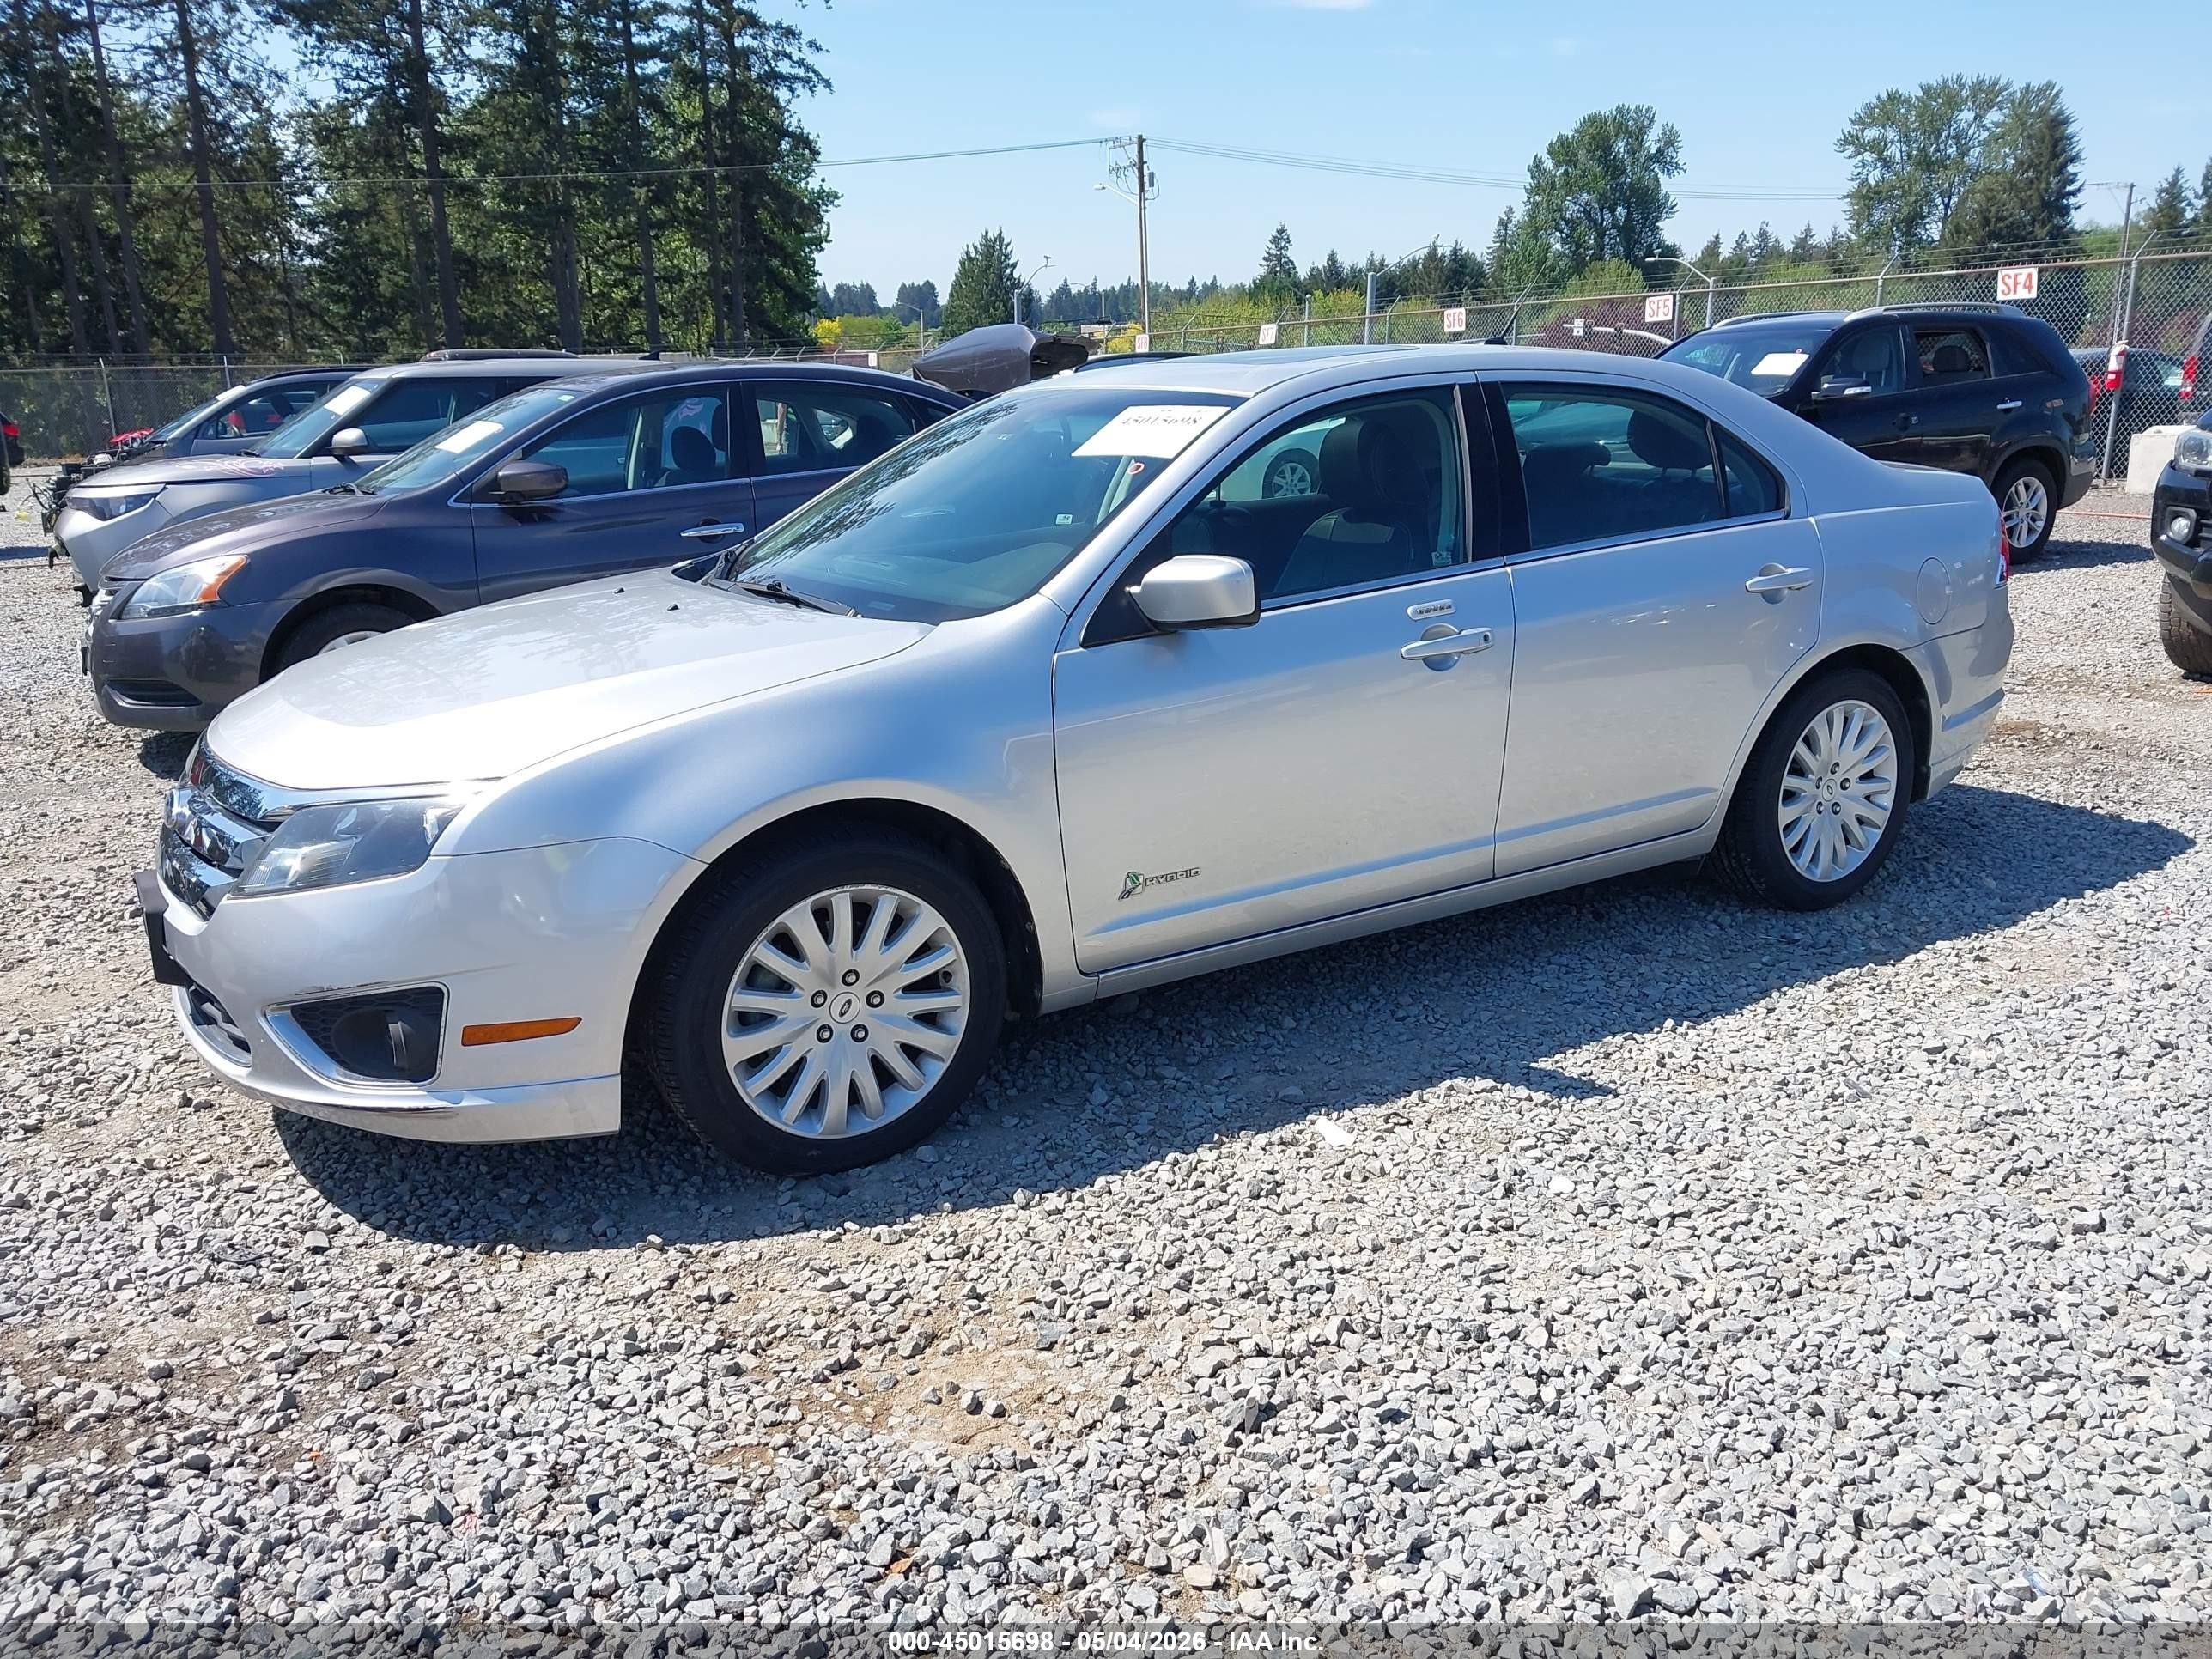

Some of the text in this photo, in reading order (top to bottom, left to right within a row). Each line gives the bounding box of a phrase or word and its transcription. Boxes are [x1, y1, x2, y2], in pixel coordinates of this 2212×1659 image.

[2001, 271, 2034, 296] SF4
[1648, 298, 1670, 318] SF5
[1446, 311, 1464, 329] SF6
[1145, 866, 1201, 886] HYBRID
